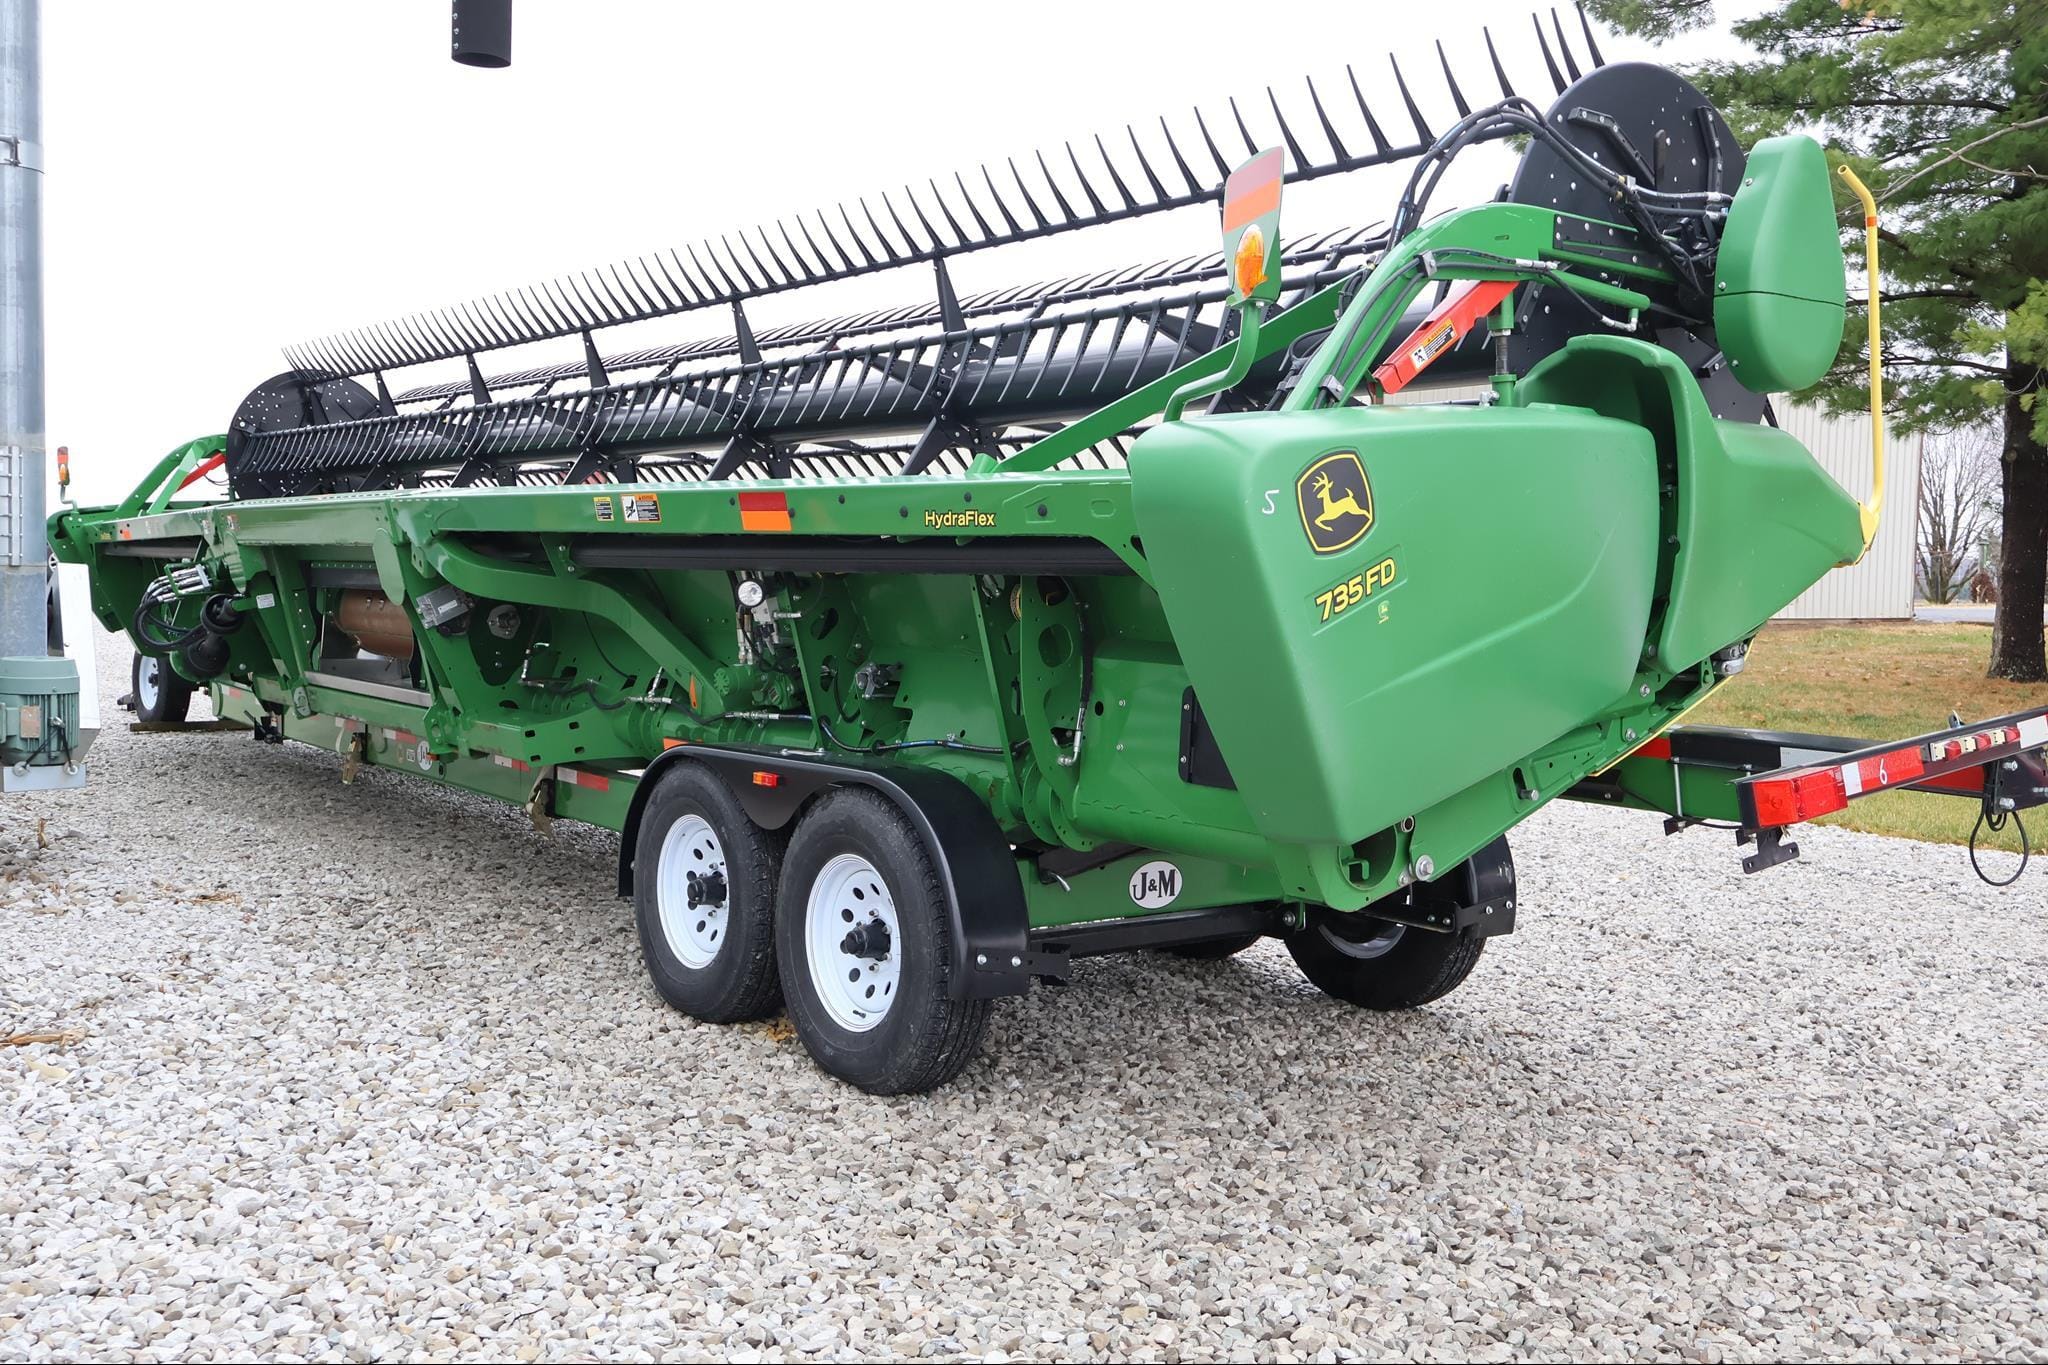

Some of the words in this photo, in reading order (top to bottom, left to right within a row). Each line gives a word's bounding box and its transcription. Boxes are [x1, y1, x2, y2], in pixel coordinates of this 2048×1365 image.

[925, 510, 996, 529] HydraFlex
[1315, 557, 1396, 622] 735FD
[1879, 758, 1888, 785] 6
[1132, 869, 1176, 900] J&M
